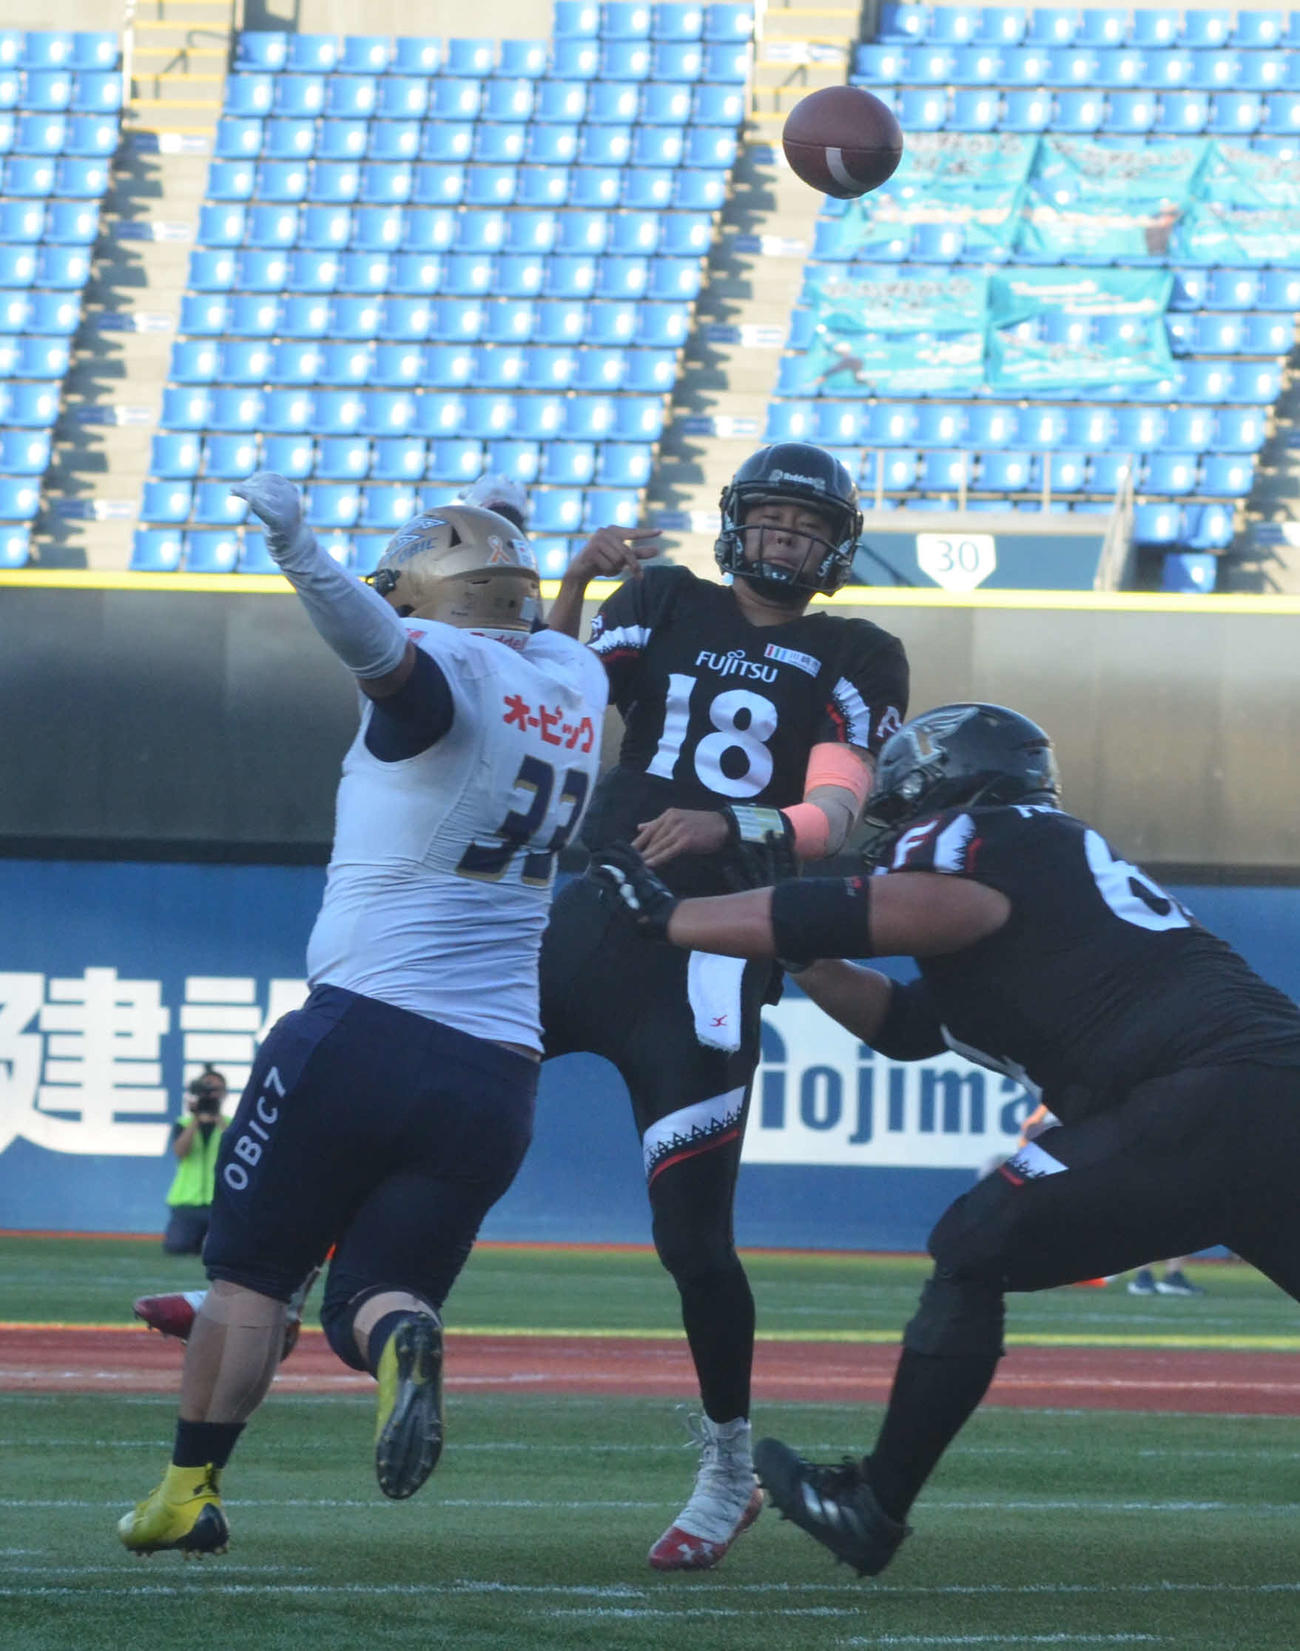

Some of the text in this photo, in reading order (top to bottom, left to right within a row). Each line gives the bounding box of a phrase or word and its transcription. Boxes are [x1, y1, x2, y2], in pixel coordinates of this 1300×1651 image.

[936, 540, 980, 573] 30
[695, 649, 779, 683] FUJITSU
[503, 694, 594, 753] オービック
[645, 673, 778, 799] 18
